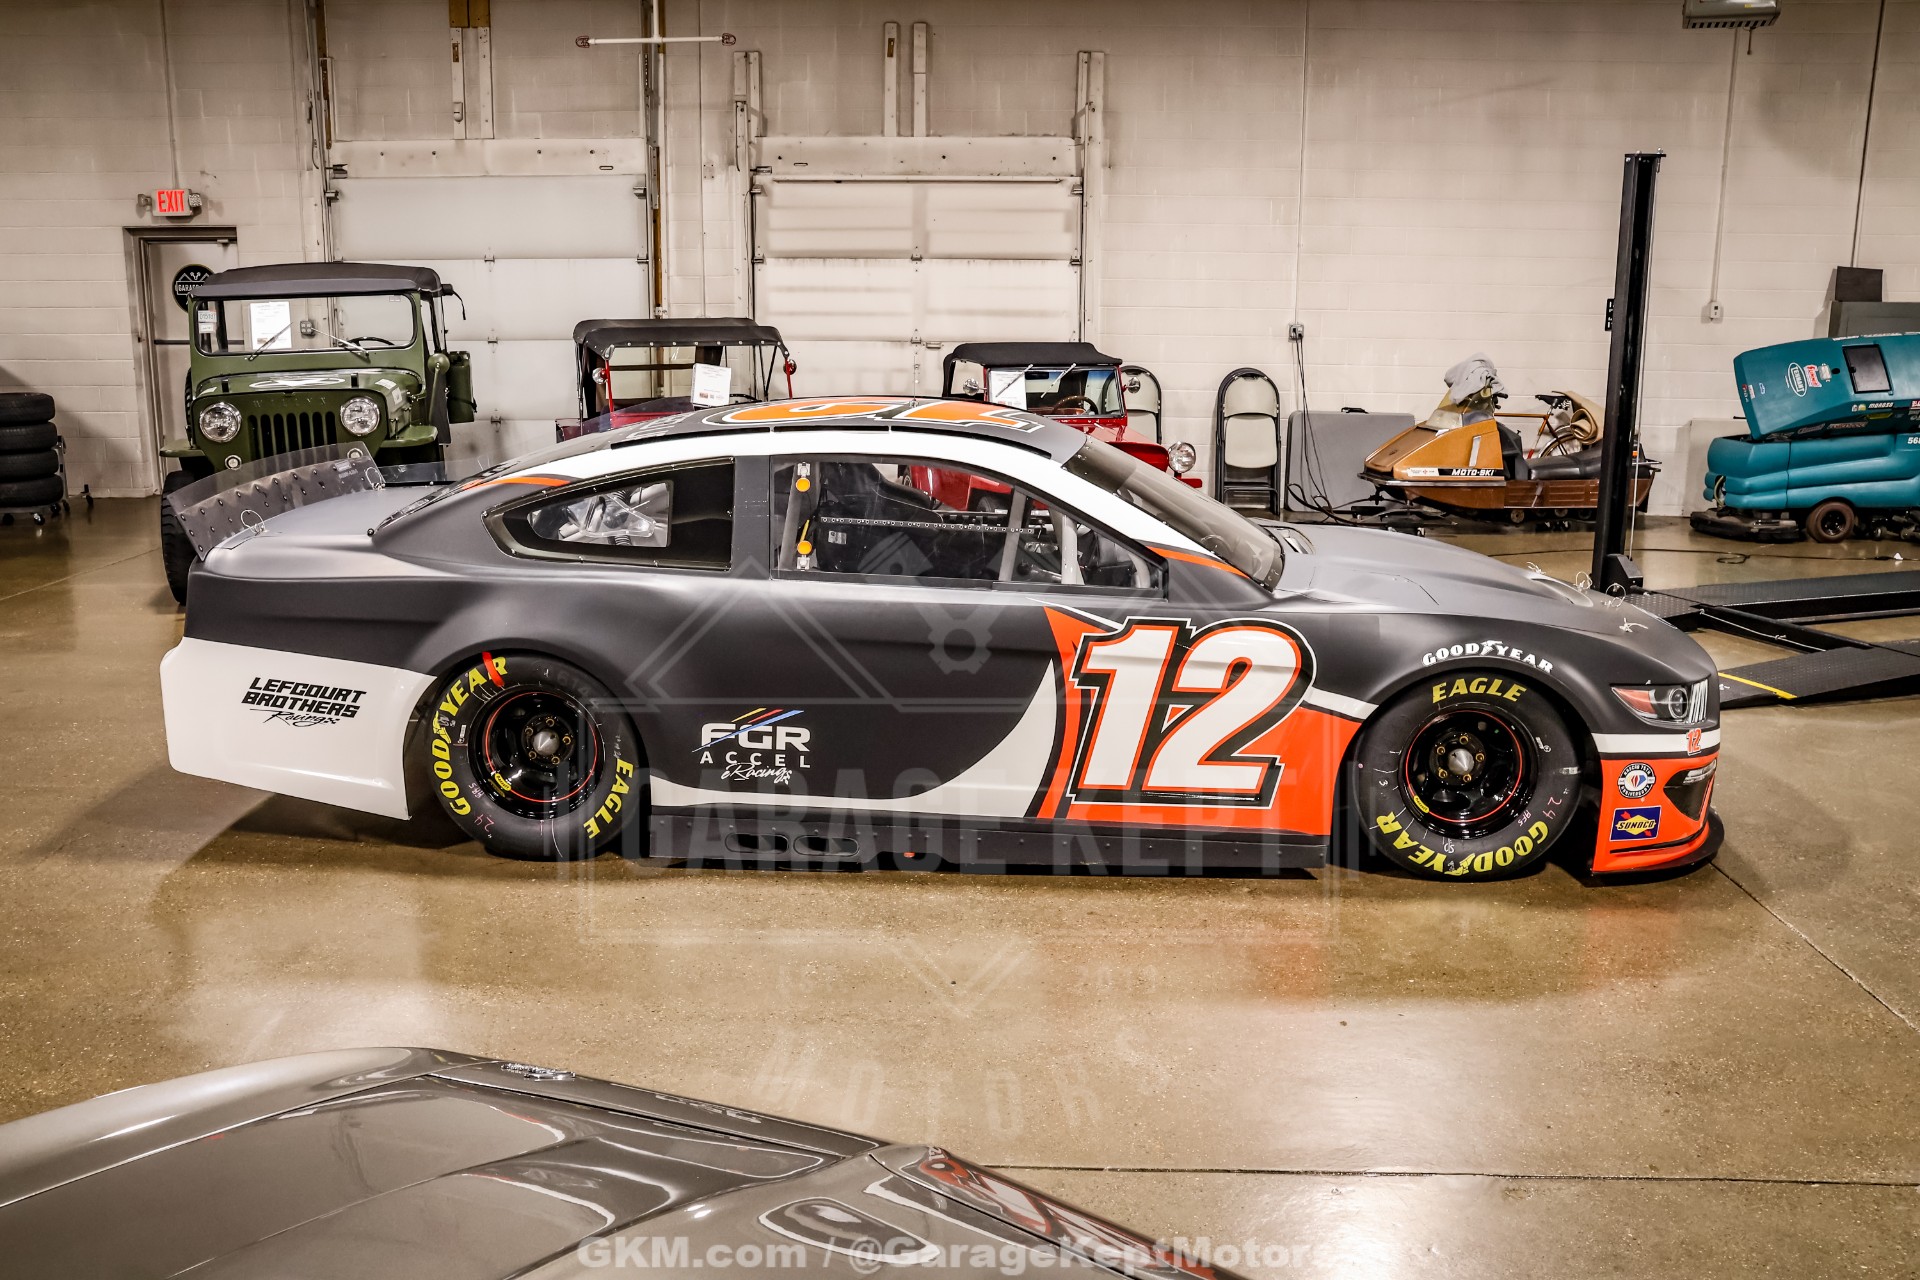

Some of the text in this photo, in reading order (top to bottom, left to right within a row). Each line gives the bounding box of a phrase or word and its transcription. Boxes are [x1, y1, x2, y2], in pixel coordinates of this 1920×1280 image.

[157, 190, 185, 212] EXIT
[1907, 437, 1920, 445] 56
[1422, 641, 1554, 674] GOODYEAR
[248, 676, 367, 704] LEFCOURT
[1432, 677, 1528, 703] EAGLE
[241, 690, 361, 719] BROTHERS
[1070, 618, 1314, 806] 12
[701, 722, 811, 752] FGR
[1686, 728, 1702, 755] 12
[699, 750, 811, 768] ACCEL
[583, 758, 634, 839] EAGLE
[1618, 820, 1656, 830] SUNOCO
[1376, 811, 1549, 875] GOODYEAR
